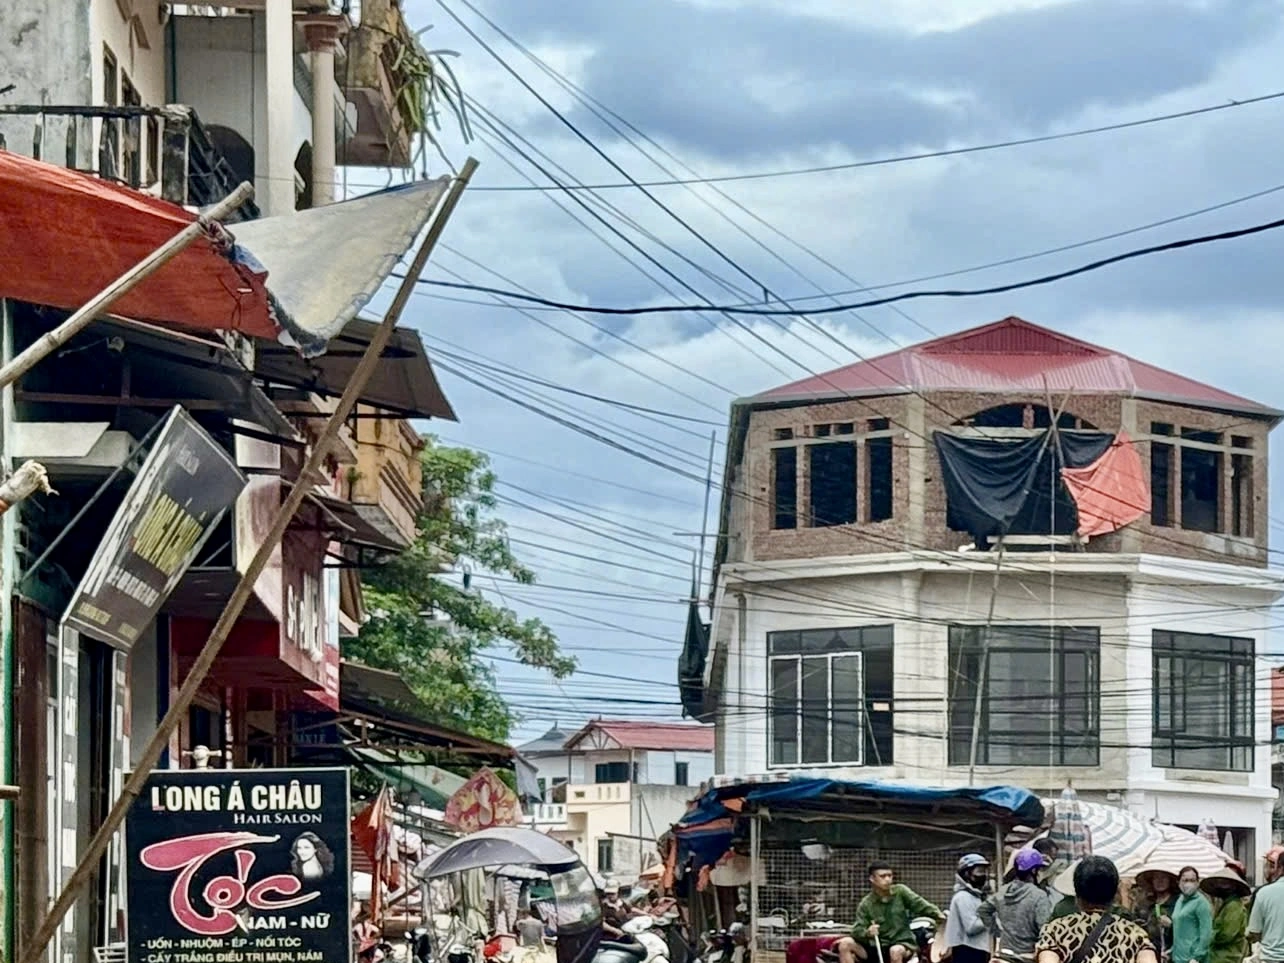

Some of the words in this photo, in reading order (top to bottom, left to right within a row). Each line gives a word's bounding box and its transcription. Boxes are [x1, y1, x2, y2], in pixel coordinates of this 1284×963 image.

[152, 785, 220, 812] LONG
[227, 780, 246, 811] Á
[251, 779, 322, 811] CHÂU
[234, 813, 272, 824] HAIR
[275, 813, 323, 824] SALON
[140, 831, 322, 935] Tóc
[301, 912, 331, 930] NỮ
[147, 936, 173, 949] UỐN
[180, 938, 224, 950] NHUỘM
[231, 936, 248, 949] ÉP
[255, 936, 275, 948] NỐI
[277, 936, 302, 948] TÓC
